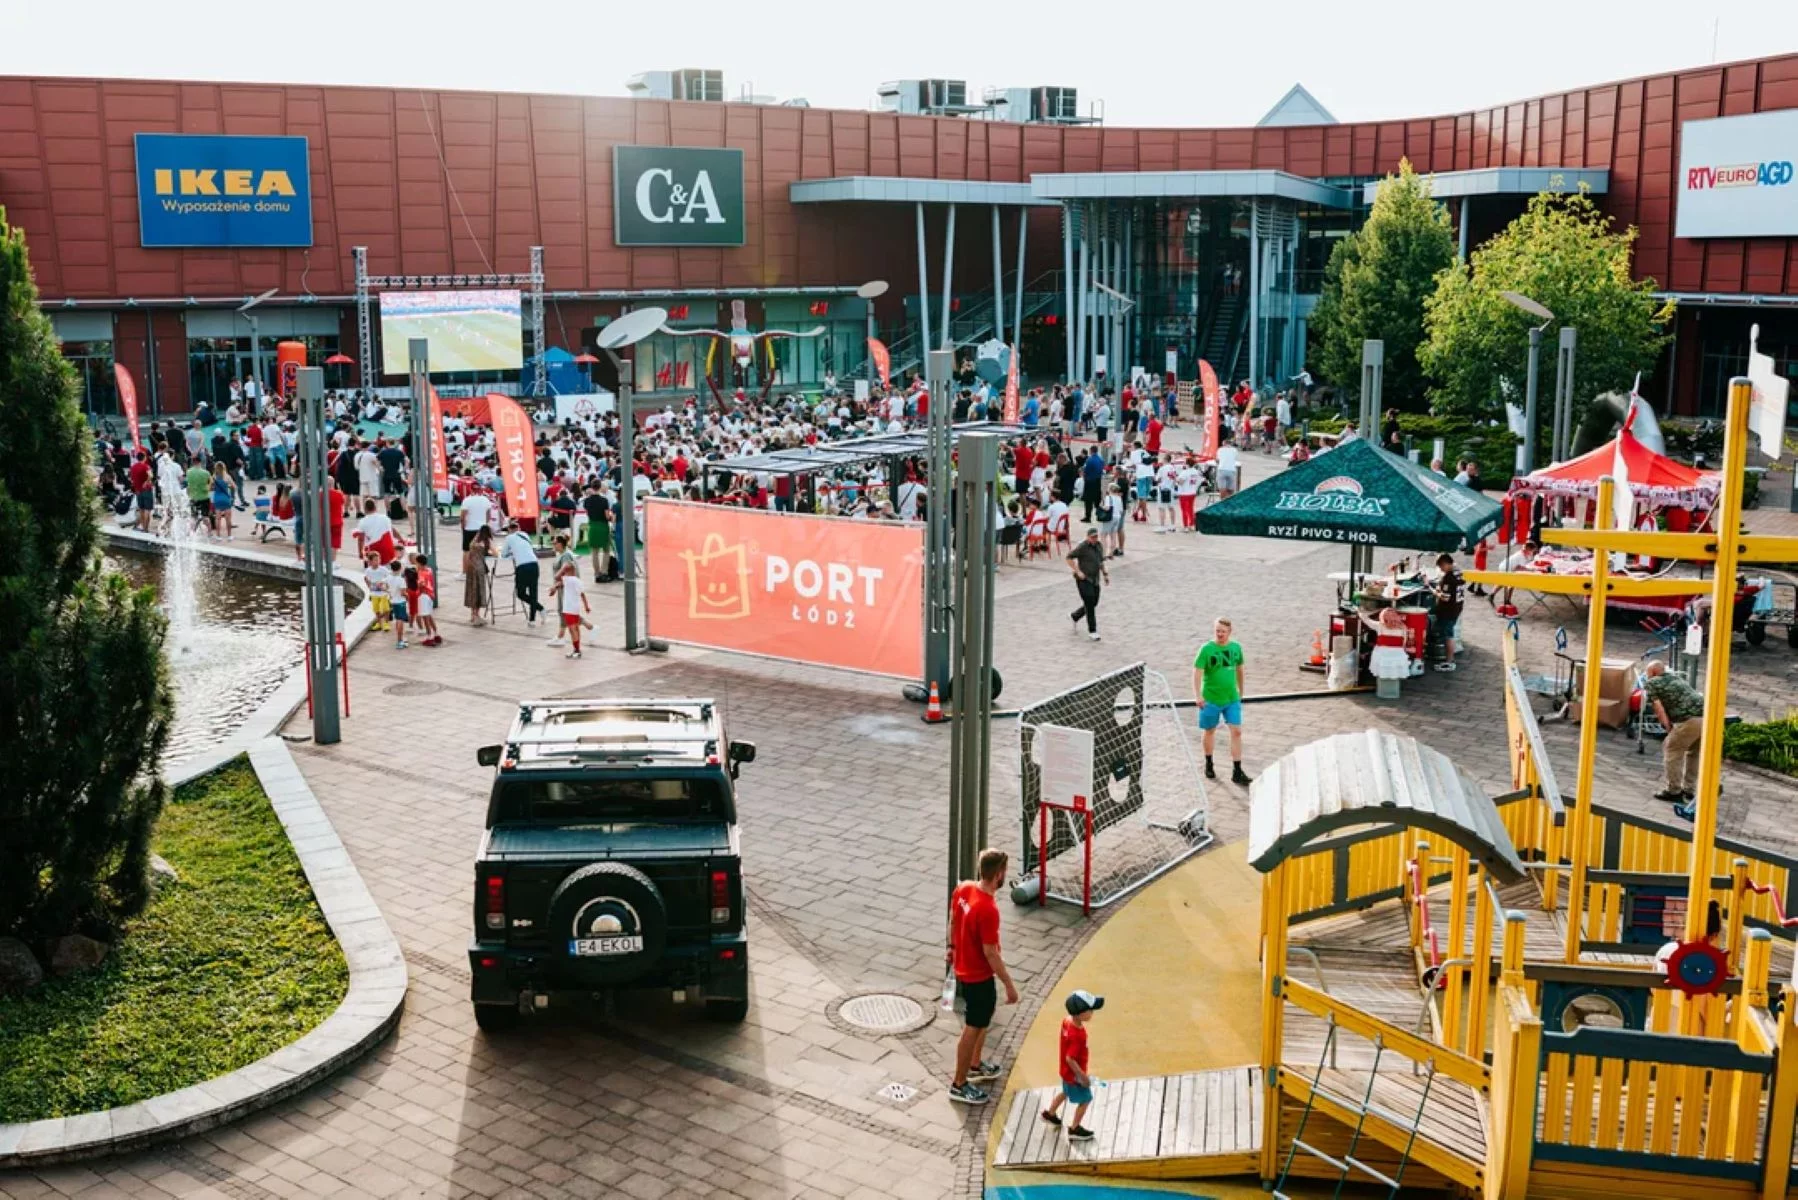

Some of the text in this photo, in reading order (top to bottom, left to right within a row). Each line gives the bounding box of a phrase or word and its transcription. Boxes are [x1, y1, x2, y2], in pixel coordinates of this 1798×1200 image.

[154, 168, 296, 195] IKEA
[1688, 161, 1793, 190] RTV EURO AGD
[161, 199, 290, 214] Wyposażenie domu
[635, 167, 727, 224] C&A
[1275, 491, 1385, 517] HOLBA
[1267, 524, 1378, 544] RYZÍ PIVO Z HOR
[765, 555, 884, 607] PORT
[792, 603, 856, 629] ŁÓDŹ
[577, 938, 641, 954] E4 EKOL
